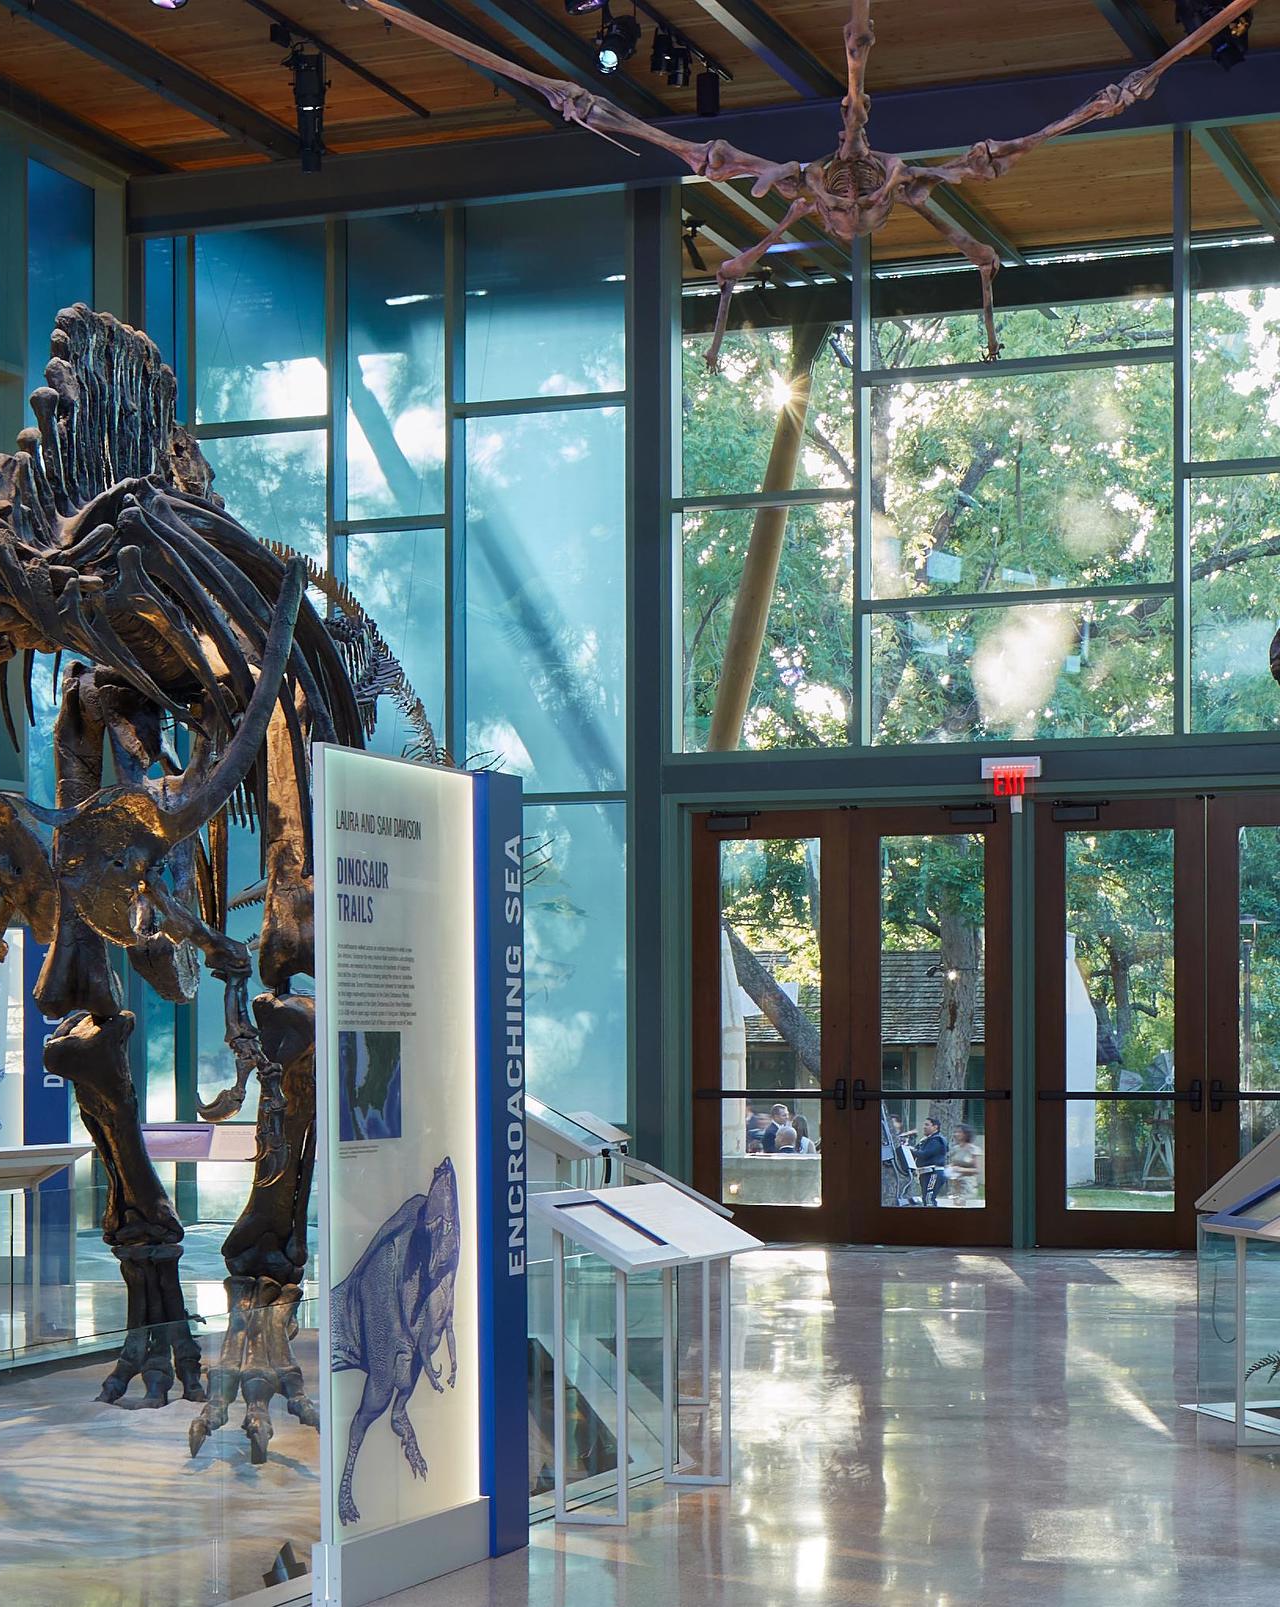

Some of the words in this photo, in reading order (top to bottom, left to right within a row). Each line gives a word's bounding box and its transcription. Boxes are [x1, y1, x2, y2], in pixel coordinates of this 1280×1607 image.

[993, 768, 1026, 796] EXIT
[336, 809, 359, 832] LAURA
[361, 813, 375, 834] AND
[377, 815, 392, 836] SAM
[394, 818, 421, 840] DAWSON
[337, 856, 389, 888] DINOSAUR
[504, 834, 522, 925] SEA
[337, 893, 373, 923] TRAILS
[505, 945, 525, 1277] ENCROACHING
